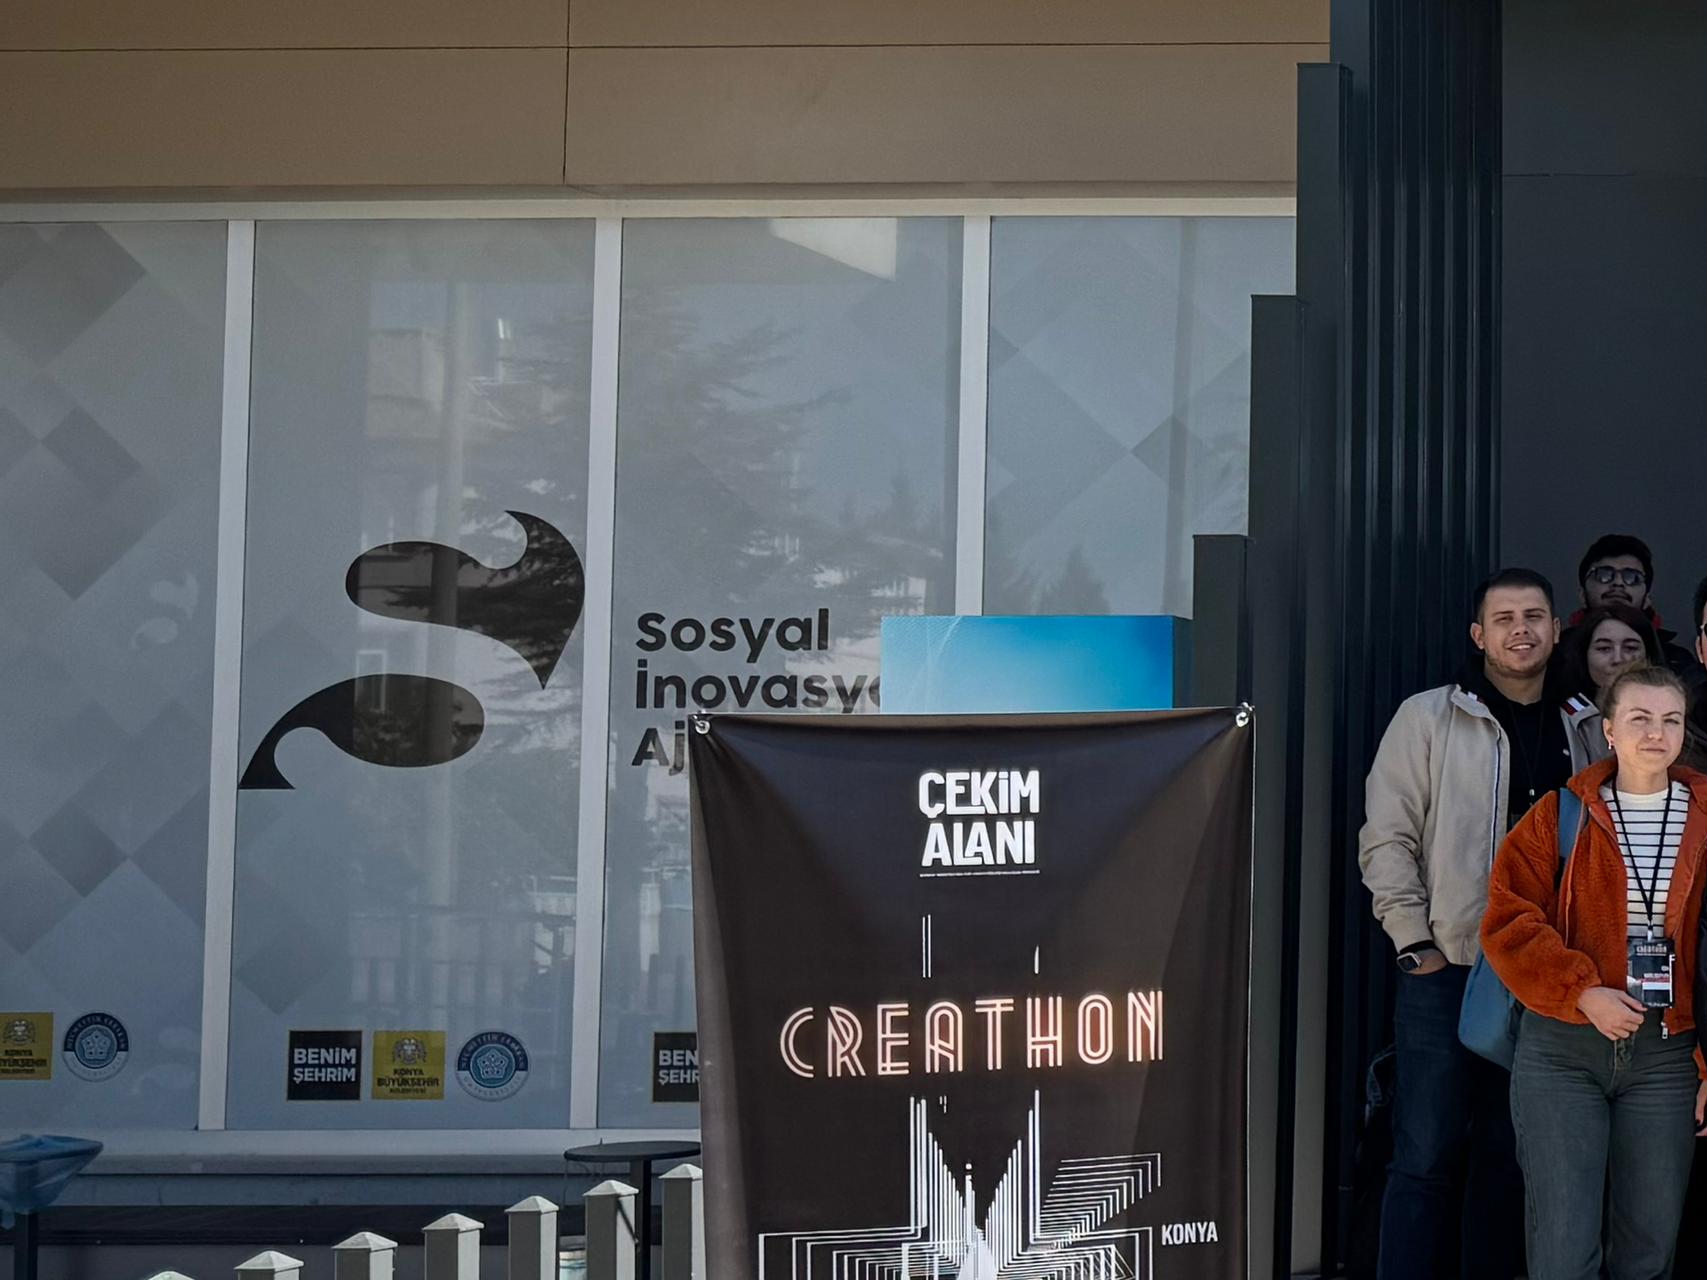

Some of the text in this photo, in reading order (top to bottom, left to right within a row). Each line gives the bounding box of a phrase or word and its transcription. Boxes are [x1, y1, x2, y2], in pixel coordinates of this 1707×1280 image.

[636, 608, 829, 663] Sosyal
[919, 770, 1040, 819] ÇEKİM
[922, 820, 1035, 867] ALANI
[294, 1047, 356, 1064] BENİM
[780, 990, 1164, 1079] CREATHON
[293, 1067, 356, 1084] ŞEHRİM
[1161, 1221, 1219, 1246] KONYA
